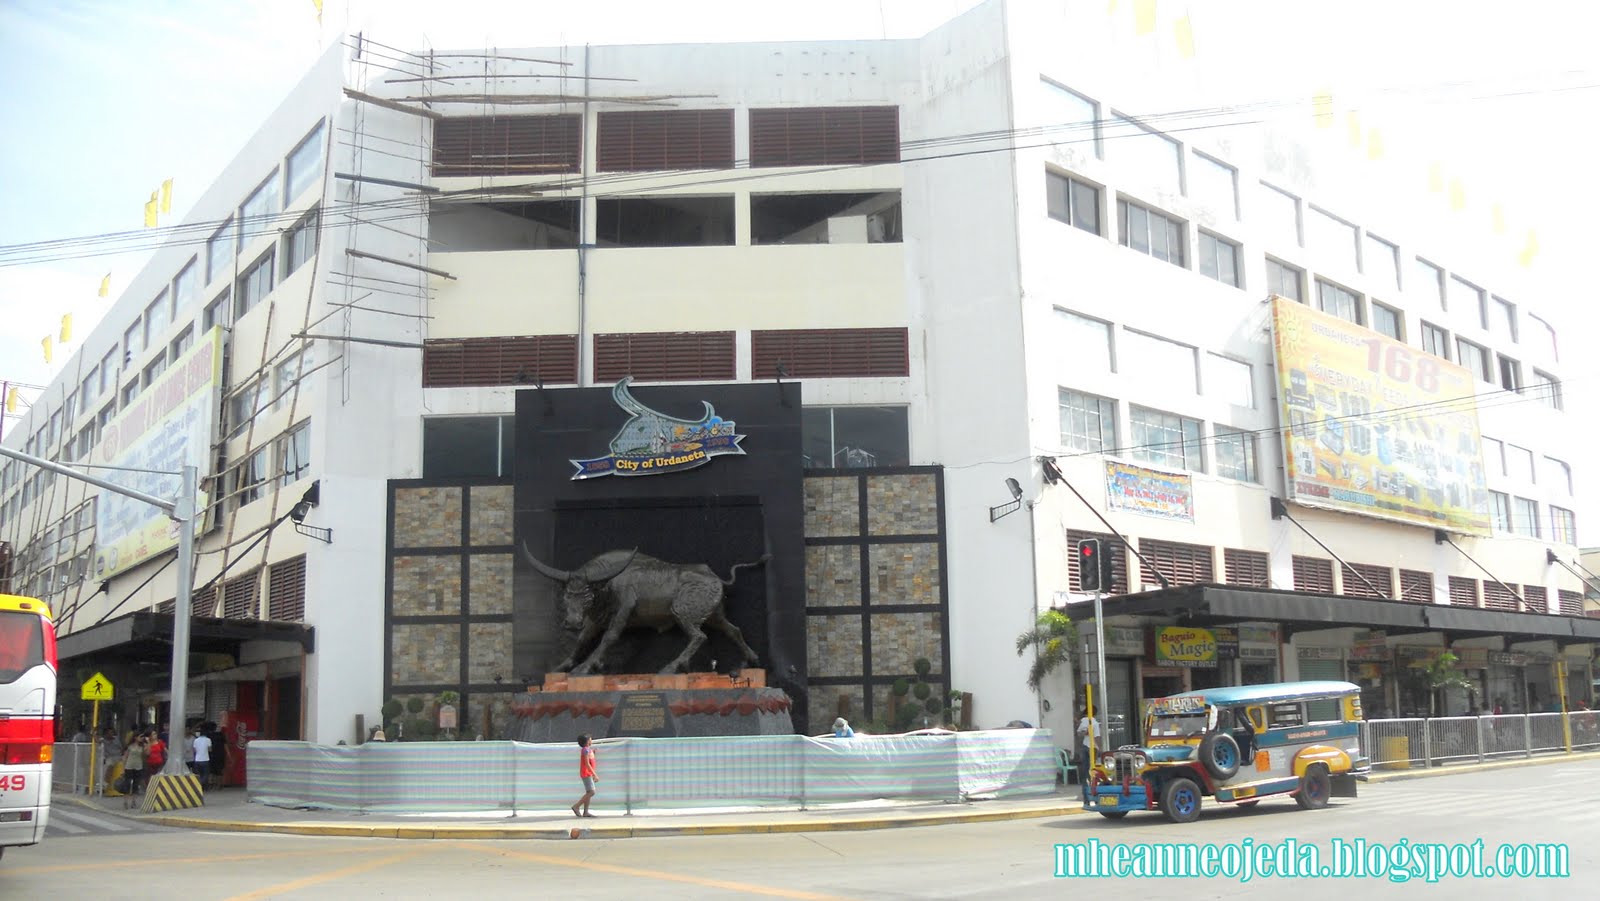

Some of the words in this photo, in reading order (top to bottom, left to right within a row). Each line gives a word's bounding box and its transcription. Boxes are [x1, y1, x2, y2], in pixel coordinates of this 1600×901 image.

[1362, 337, 1441, 394] 168
[616, 459, 639, 471] City
[642, 458, 654, 468] of
[655, 450, 706, 467] Urdaneta
[1161, 631, 1196, 644] Baguio
[1169, 640, 1215, 658] Magic
